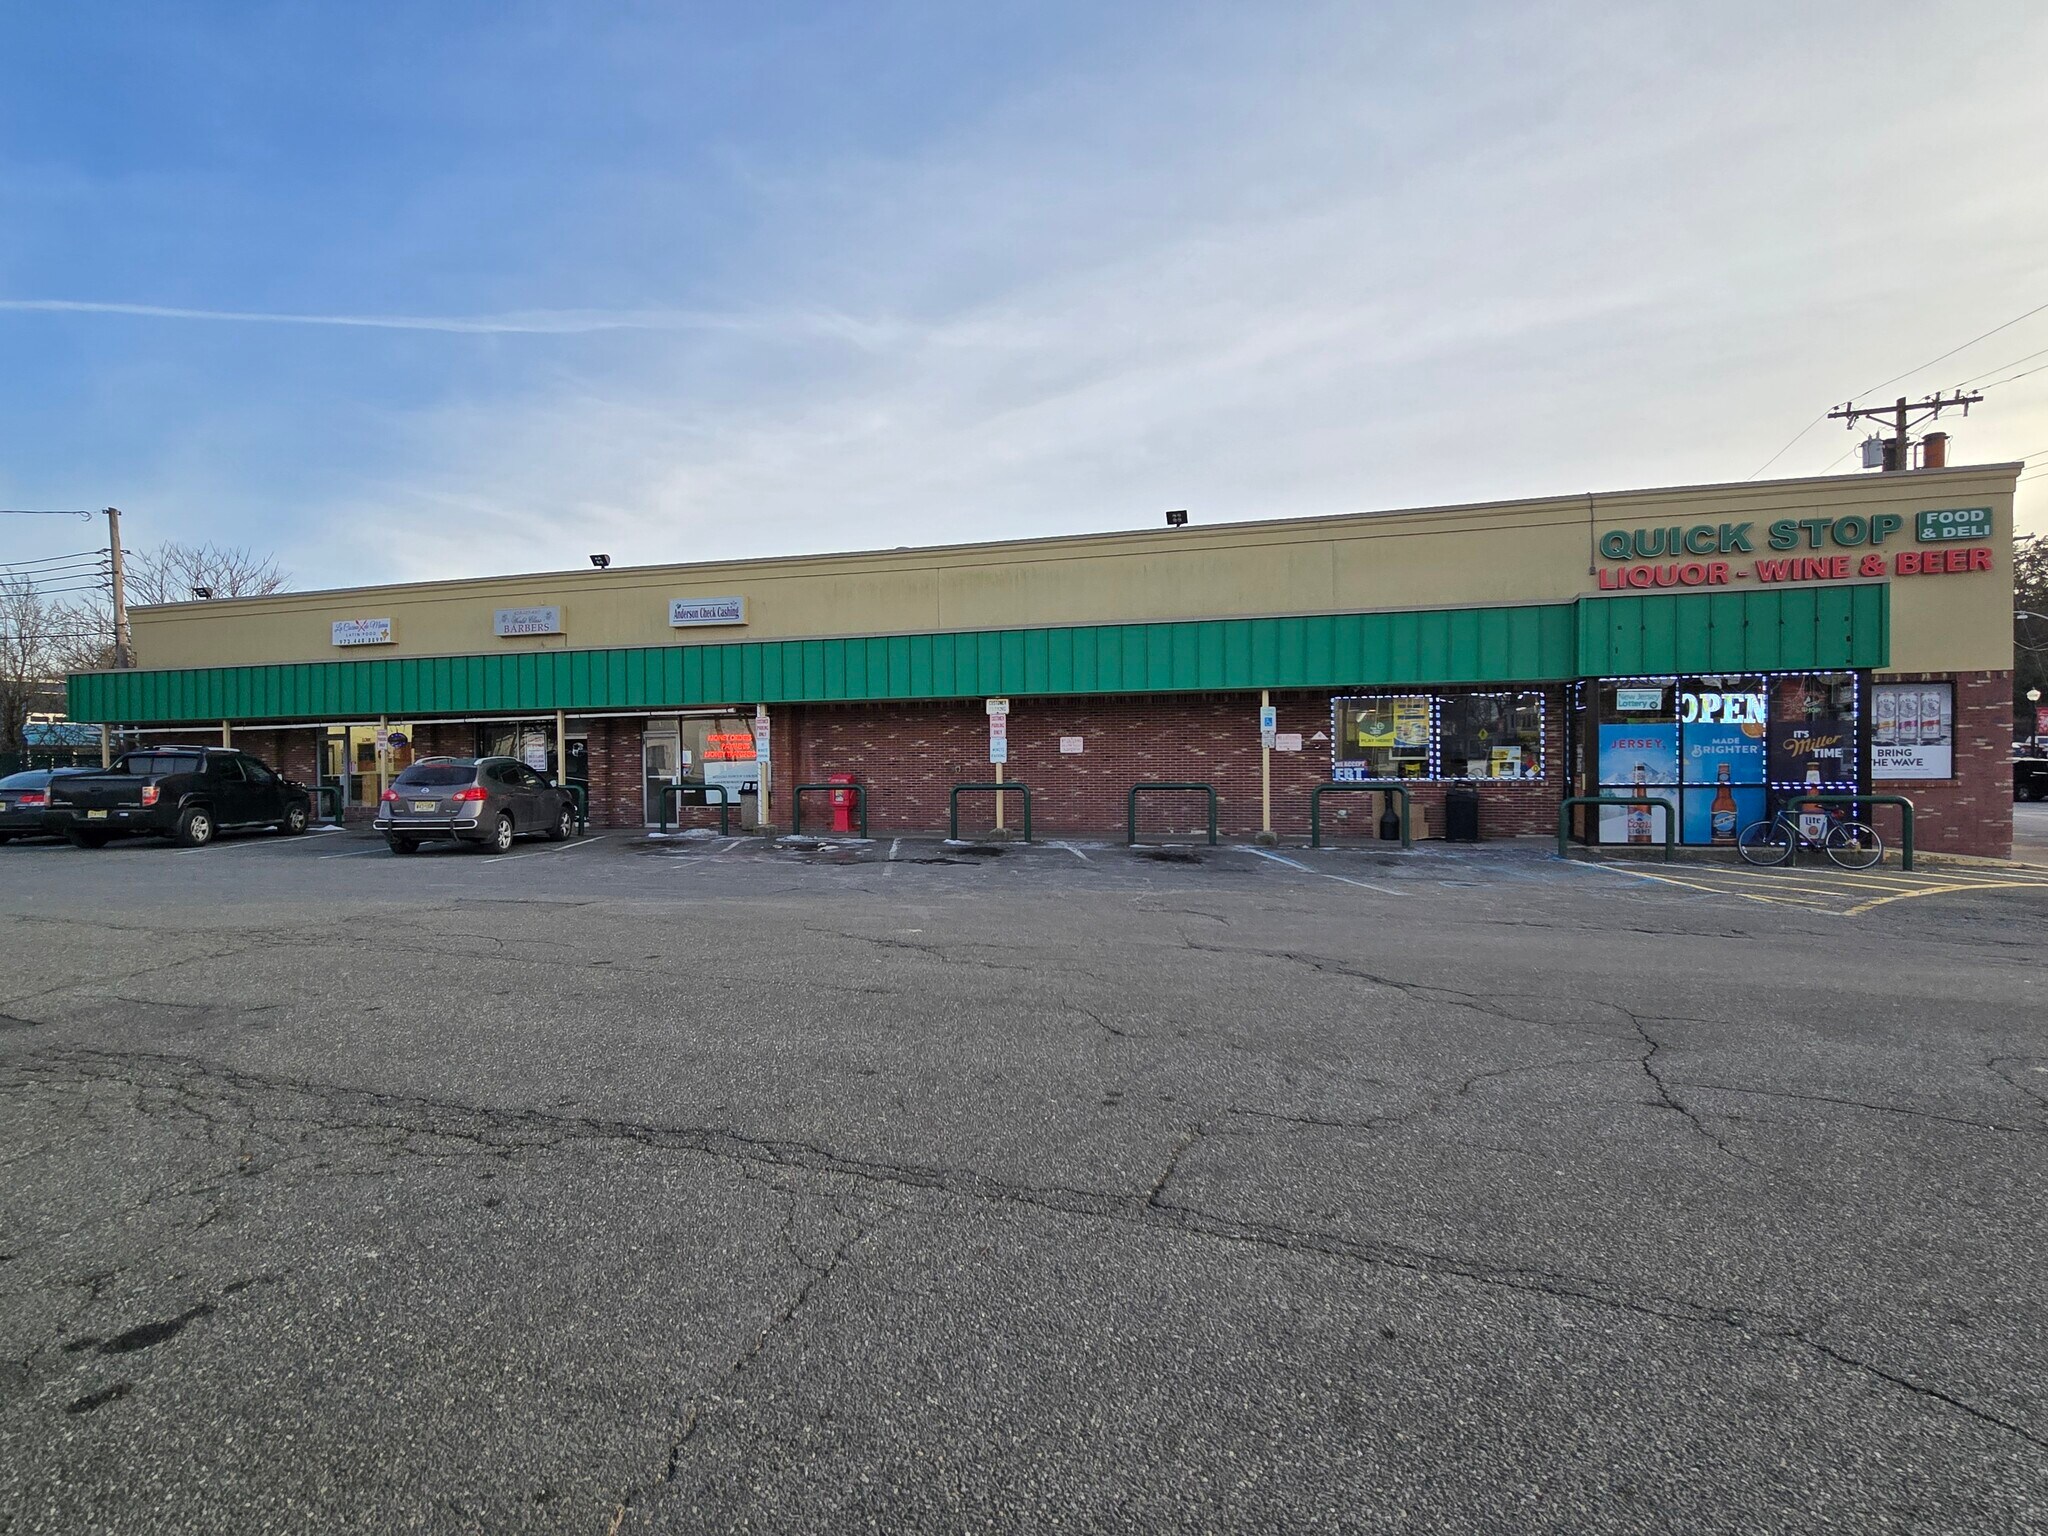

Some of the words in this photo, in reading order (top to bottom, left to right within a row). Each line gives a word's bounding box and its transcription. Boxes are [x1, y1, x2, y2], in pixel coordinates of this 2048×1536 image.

[1926, 509, 1985, 525] FOOD
[1600, 521, 1755, 561] QUICK
[1769, 513, 1904, 551] STOP
[1921, 527, 1936, 539] &
[1942, 524, 1991, 539] DELI
[1598, 561, 1730, 590] LIQUOR
[1755, 555, 1852, 583] WINE
[1859, 553, 1888, 577] &
[1895, 547, 1994, 576] BEER
[674, 608, 699, 619] Anderson
[700, 607, 716, 618] Check
[717, 606, 739, 618] Cashing
[504, 623, 550, 633] BARBERS
[1638, 693, 1660, 701] Jersey
[1618, 700, 1647, 709] Lottery
[1682, 693, 1767, 724] OPEN
[1793, 730, 1809, 738] IT'S
[1611, 739, 1667, 750] JERSEY,
[1783, 734, 1842, 757] Miller
[1692, 744, 1758, 757] BRIGHTER
[1813, 748, 1843, 758] TIME
[1877, 748, 1912, 757] BRING
[1872, 758, 1888, 767] HE
[1891, 758, 1923, 767] WAVE
[1335, 768, 1365, 779] EBT
[1805, 816, 1821, 825] Lite
